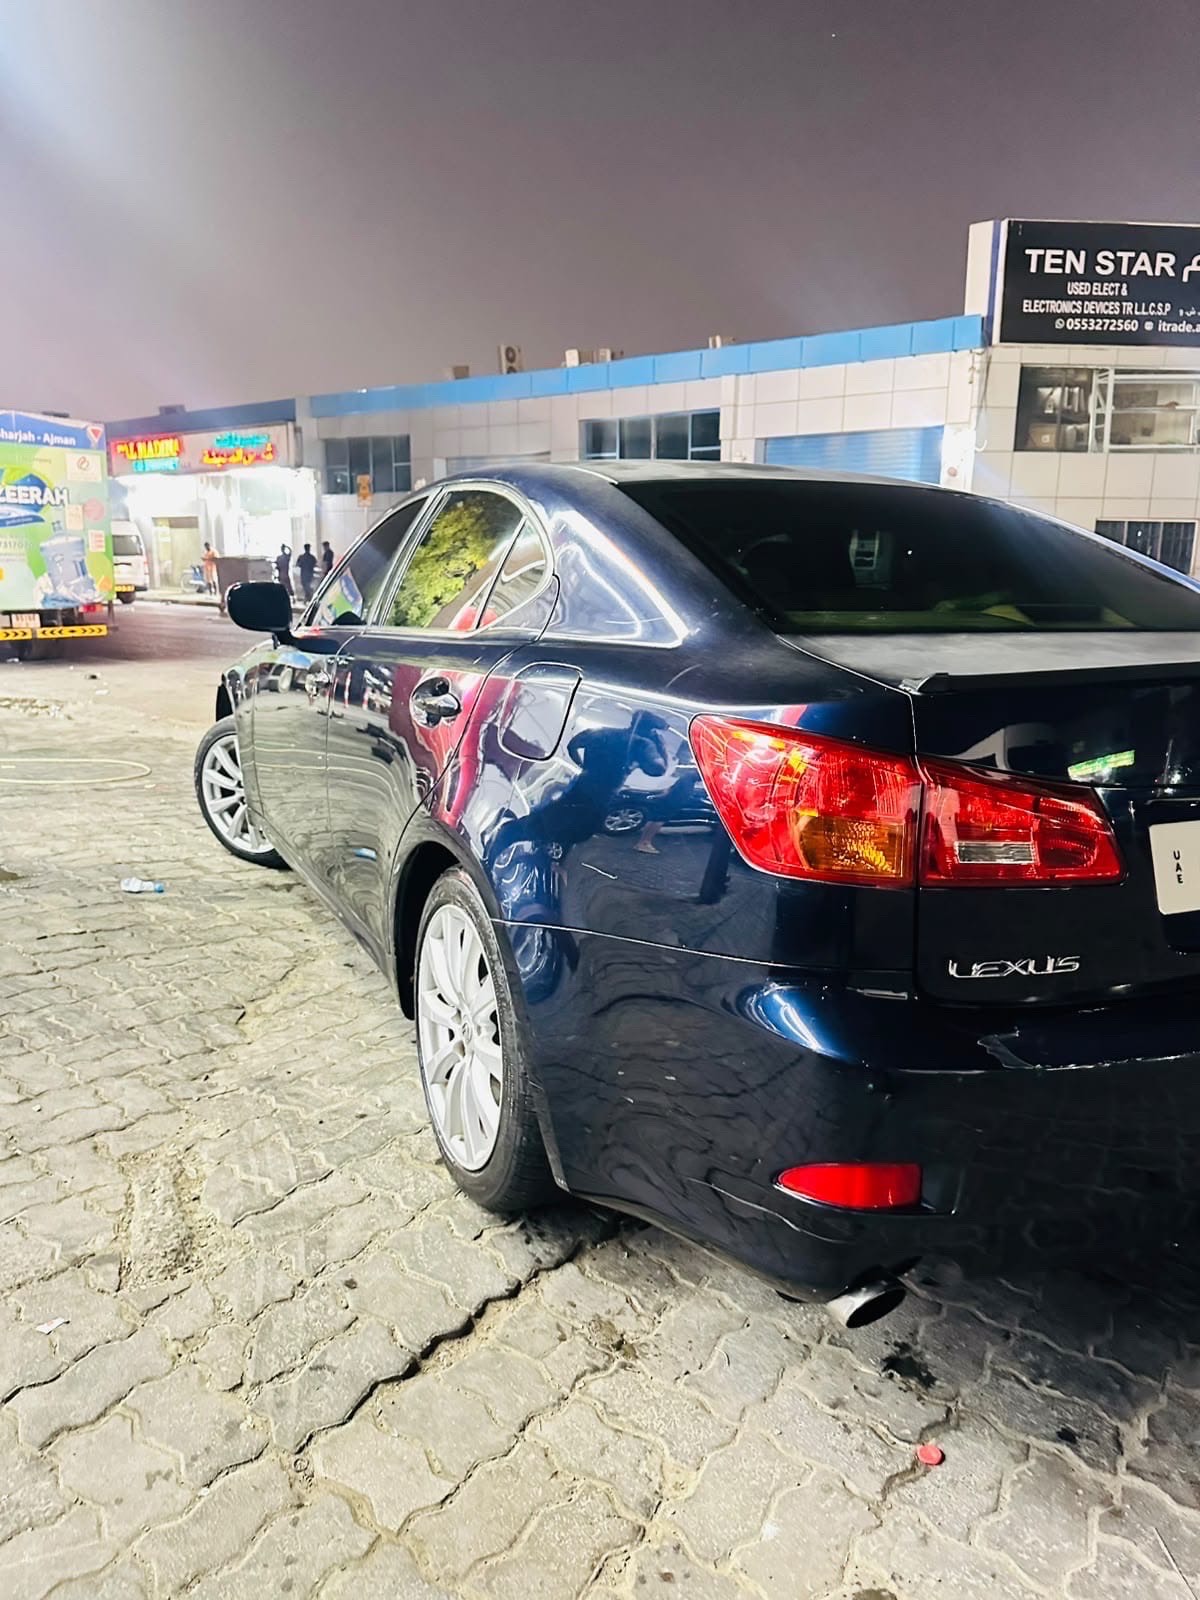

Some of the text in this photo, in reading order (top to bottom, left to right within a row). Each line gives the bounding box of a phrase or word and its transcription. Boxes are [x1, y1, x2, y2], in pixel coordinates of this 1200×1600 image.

[1025, 249, 1176, 277] TEN STAR
[1067, 282, 1128, 296] USED ELECT &
[1023, 300, 1083, 314] ELECTRONICS
[1084, 301, 1121, 315] DEVICES
[1122, 302, 1134, 315] TR
[1066, 318, 1138, 332] 0553272560
[0, 428, 36, 443] harjah
[43, 433, 77, 446] Ajman
[948, 956, 1081, 979] LEXUS
